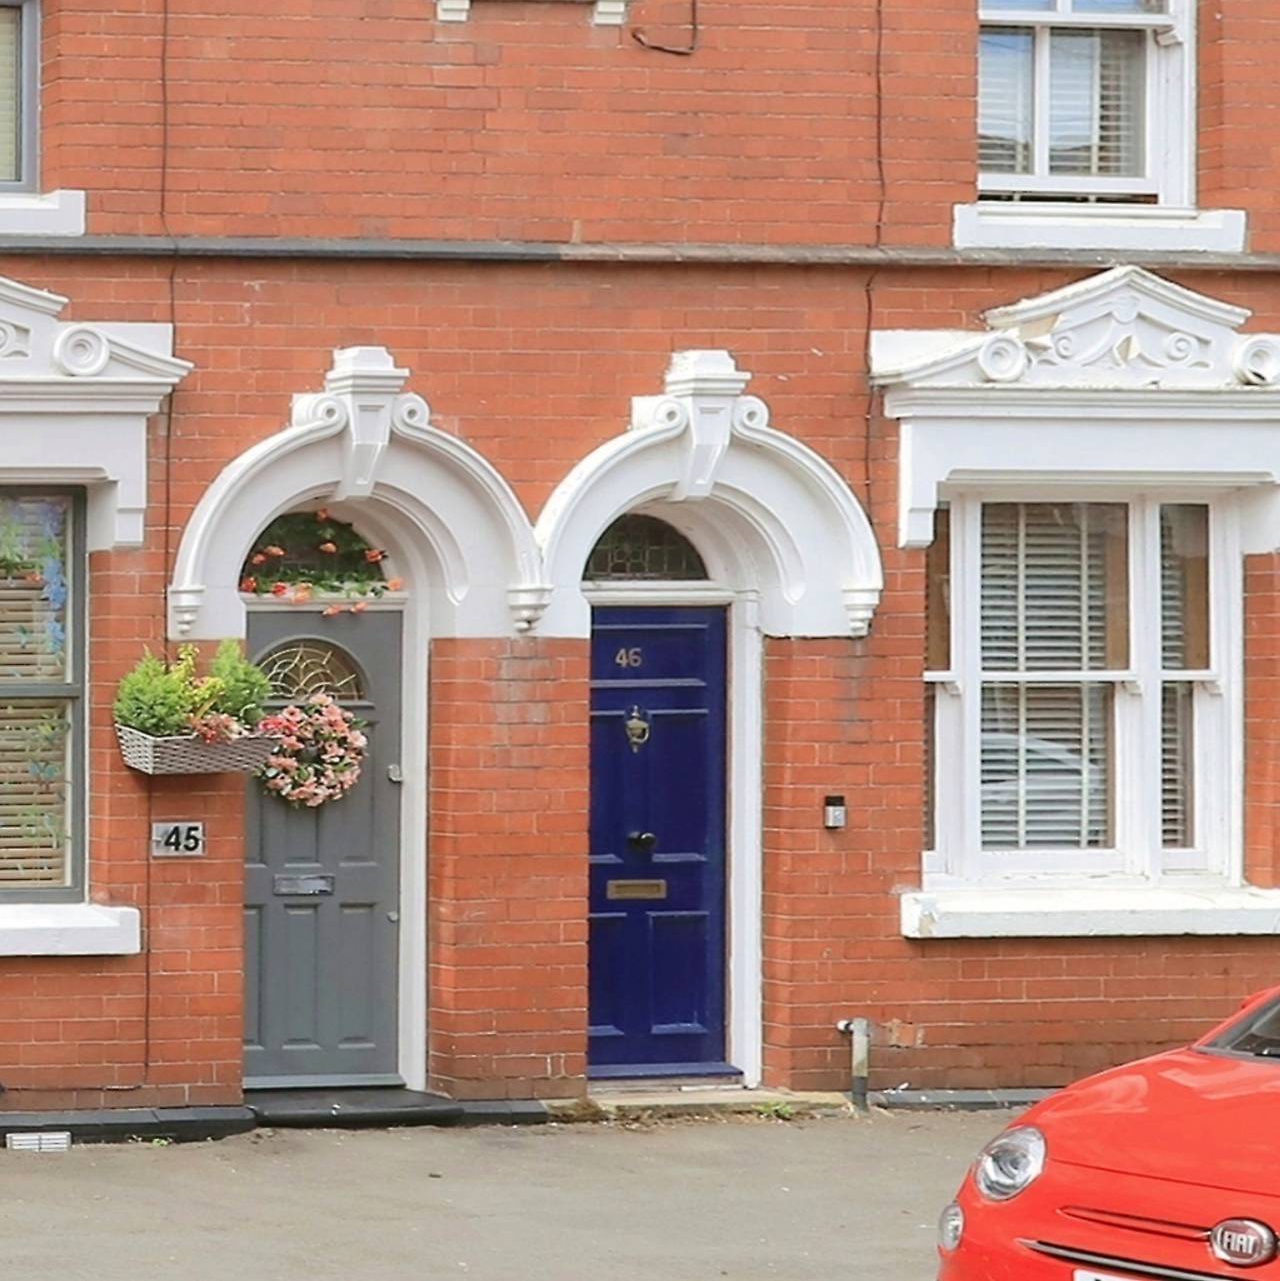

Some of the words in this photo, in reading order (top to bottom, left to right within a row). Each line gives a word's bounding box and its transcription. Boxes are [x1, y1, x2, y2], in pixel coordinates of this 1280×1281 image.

[615, 647, 642, 667] 46
[164, 825, 200, 851] 45
[1222, 1230, 1258, 1254] FIAT
